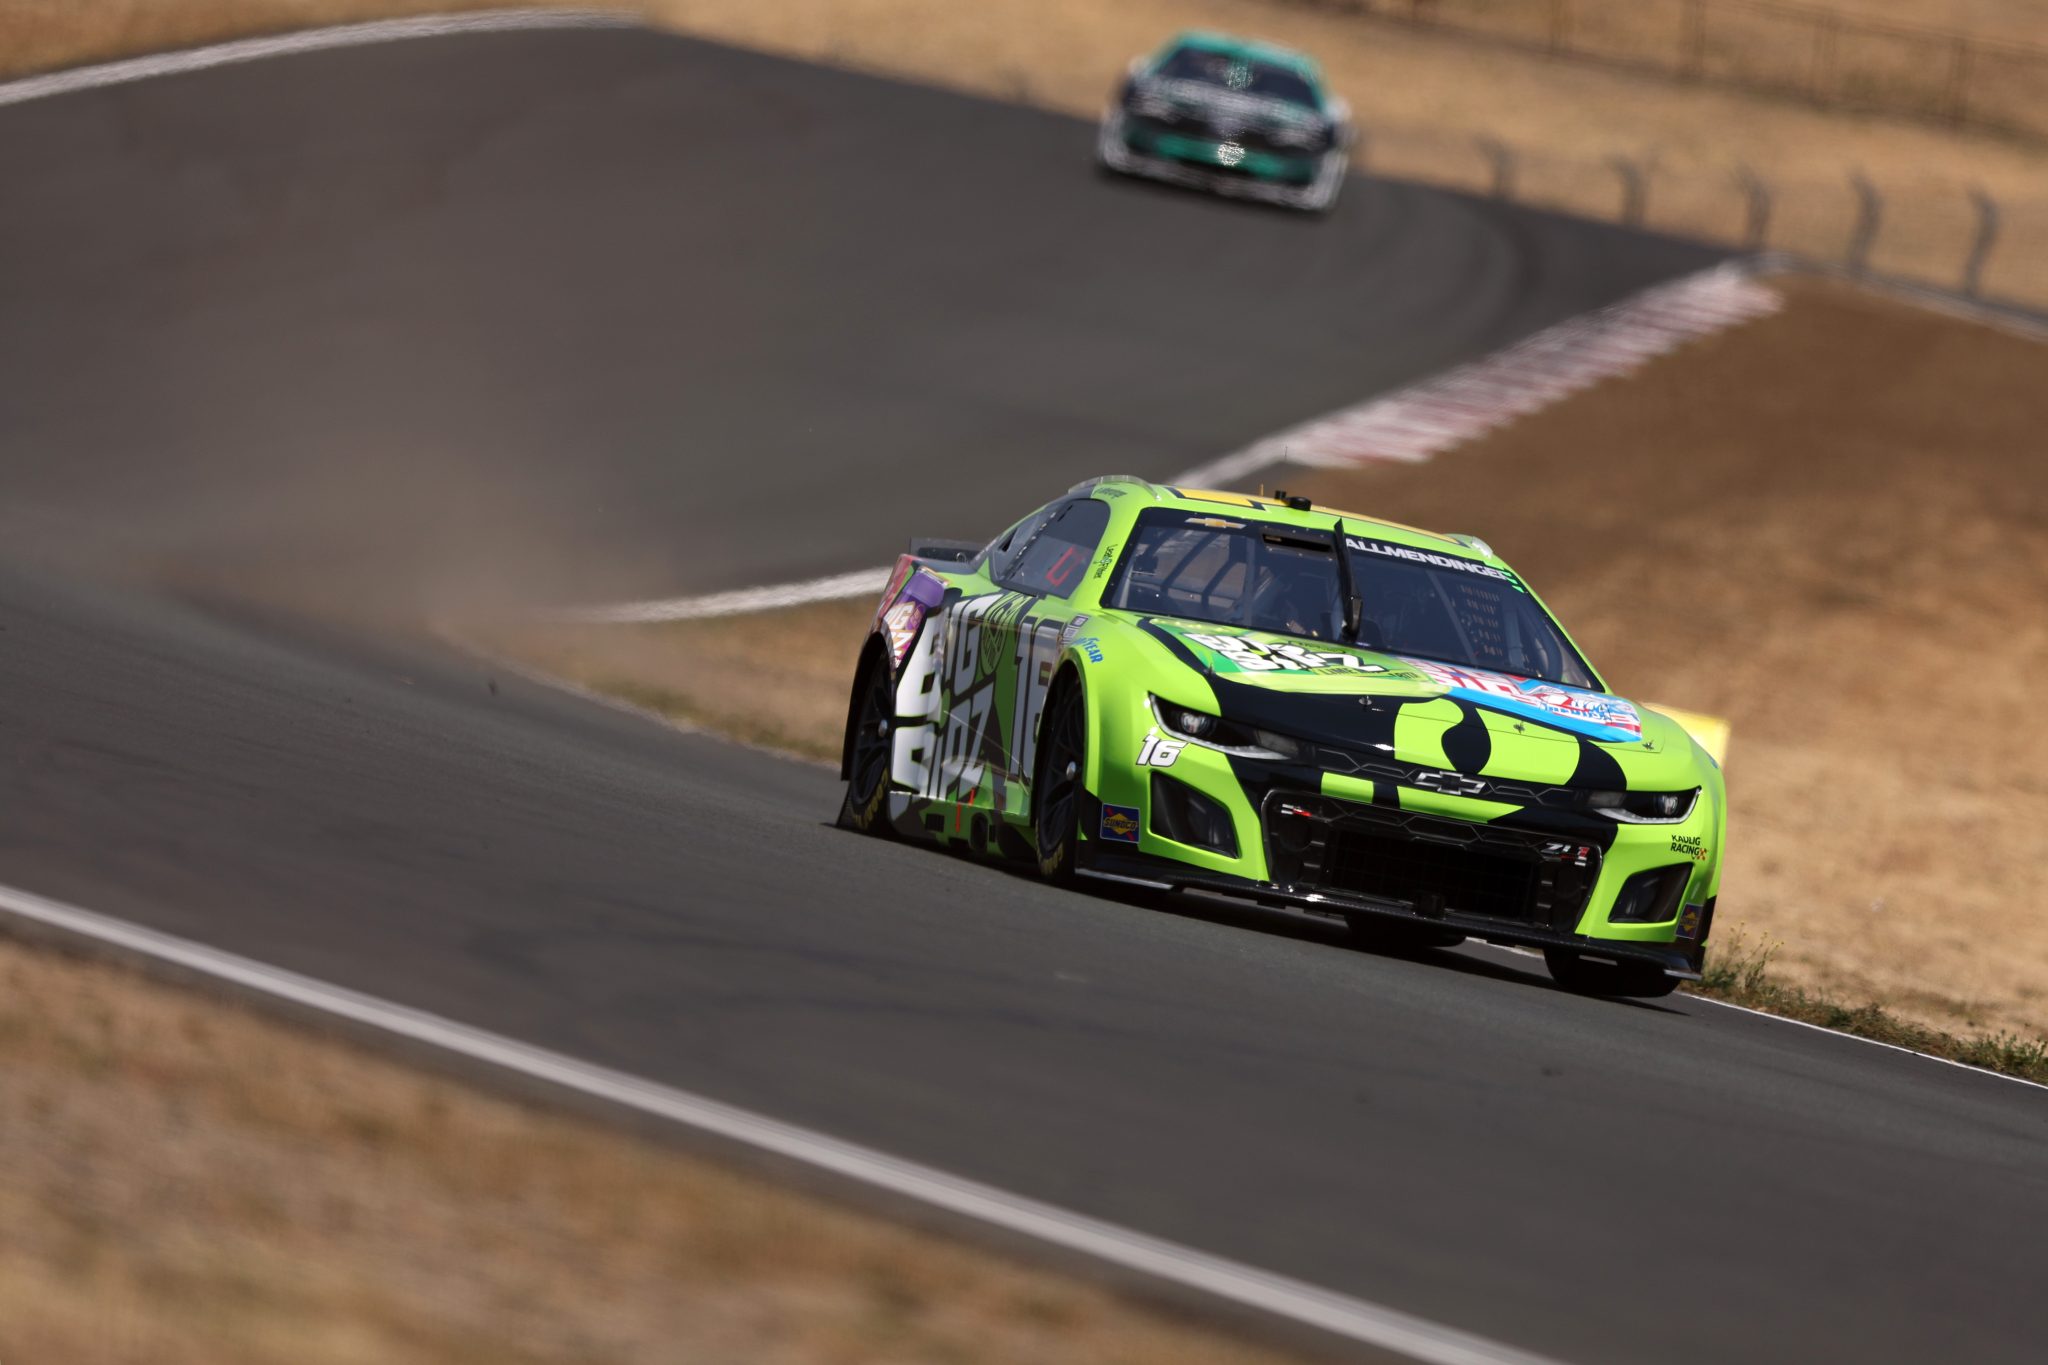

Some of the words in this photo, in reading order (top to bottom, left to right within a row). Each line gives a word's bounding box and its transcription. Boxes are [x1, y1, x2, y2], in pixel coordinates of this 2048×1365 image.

[1136, 733, 1188, 767] 16
[1103, 817, 1138, 831] SUNOCO
[1671, 834, 1701, 846] KAULIG
[1670, 842, 1701, 857] RACING
